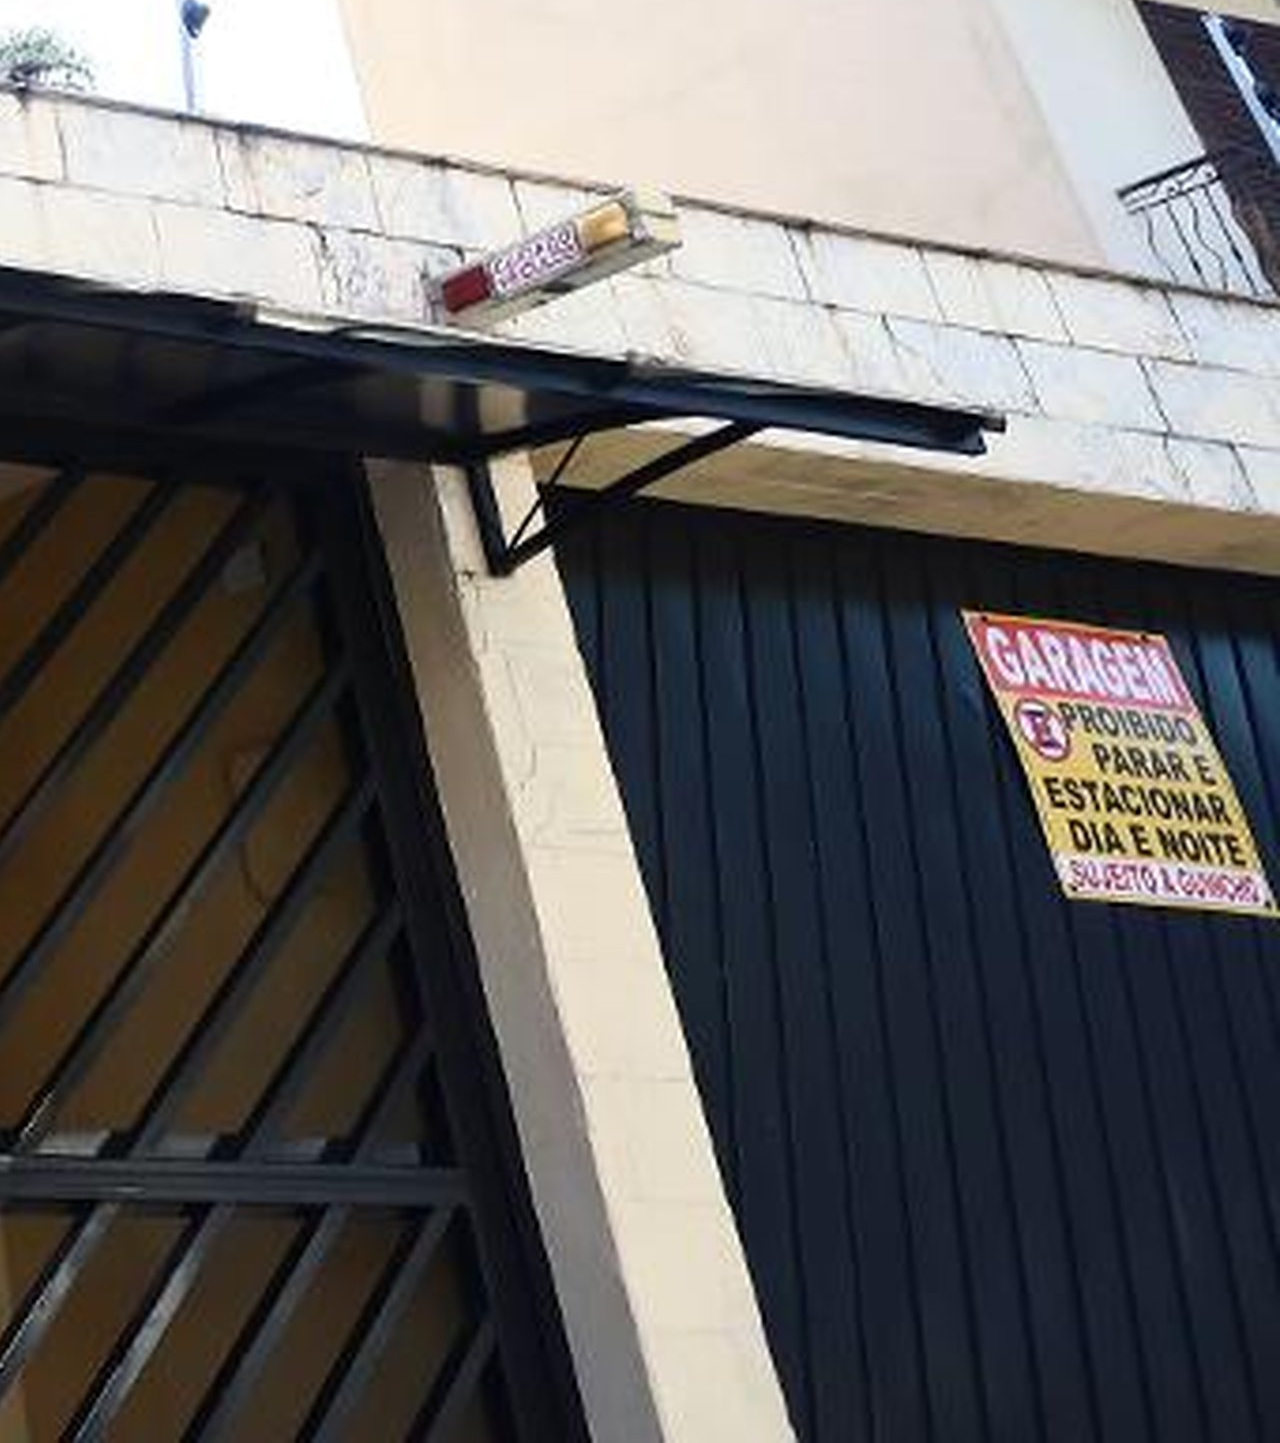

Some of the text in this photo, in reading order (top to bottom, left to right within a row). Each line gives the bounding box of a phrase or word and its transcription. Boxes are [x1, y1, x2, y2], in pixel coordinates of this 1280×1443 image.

[985, 626, 1184, 707] GARAGEM
[1058, 702, 1196, 744] PROIBIDO
[1092, 743, 1217, 785] PARAR E
[1043, 777, 1232, 825] ESTACIONAR
[1067, 820, 1247, 867] DIA E NOITE
